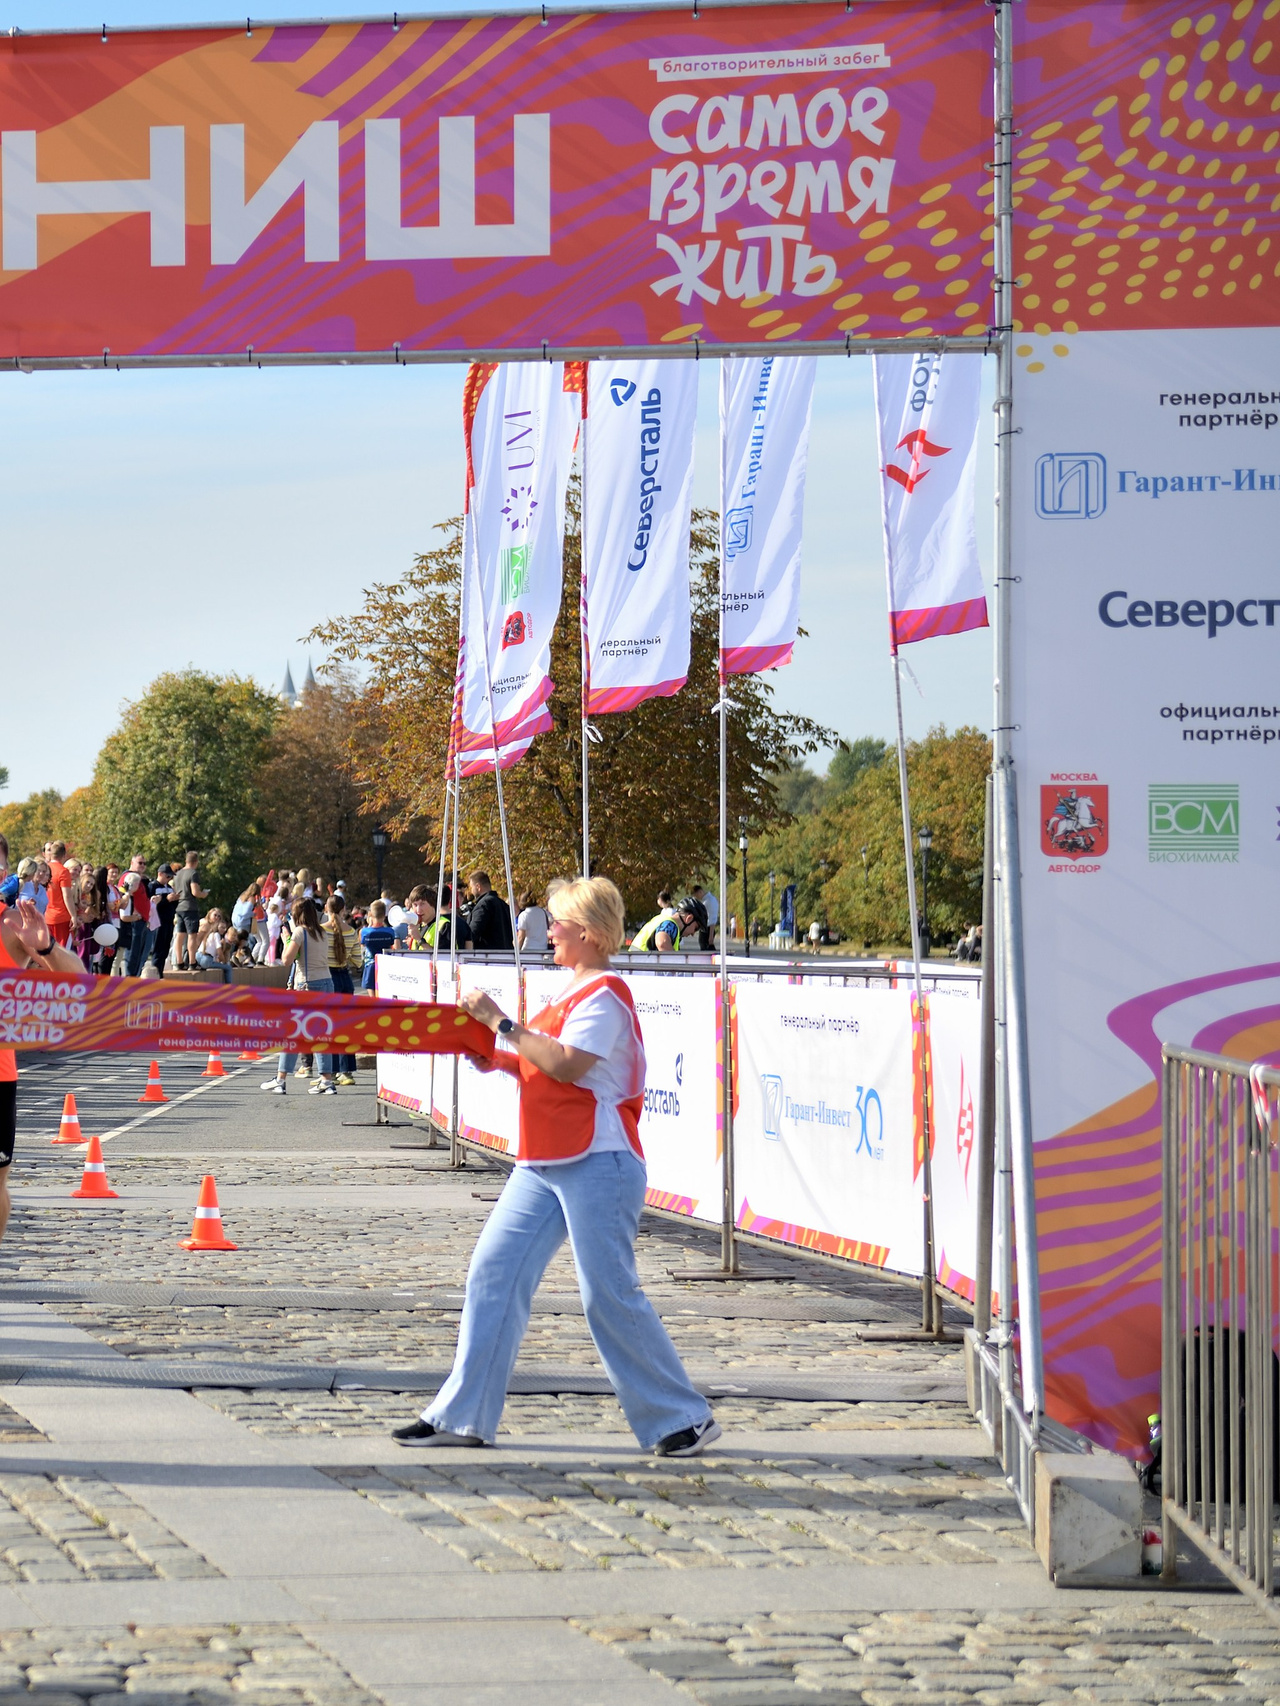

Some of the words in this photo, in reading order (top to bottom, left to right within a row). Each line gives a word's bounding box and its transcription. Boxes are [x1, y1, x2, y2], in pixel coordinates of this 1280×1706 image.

[662, 53, 828, 74] благотворительный
[833, 51, 881, 67] забег
[648, 86, 890, 155] самое
[648, 155, 897, 234] время
[649, 224, 838, 306] жить
[741, 356, 775, 499] Гарант-Инве
[627, 388, 662, 572] Северсталь
[602, 646, 648, 658] партнёр
[1182, 725, 1280, 744] партнёр
[1050, 773, 1099, 782] МОСКВА
[1048, 864, 1101, 874] АВТОДОР
[1148, 852, 1239, 863] БИОХИММАК
[167, 1009, 283, 1029] Гарант-Инвест
[287, 1009, 333, 1039] 30
[158, 1037, 241, 1048] генеральный
[244, 1039, 298, 1050] партнёр
[784, 1095, 852, 1128] Гарант-Инвест
[855, 1085, 883, 1158] 30
